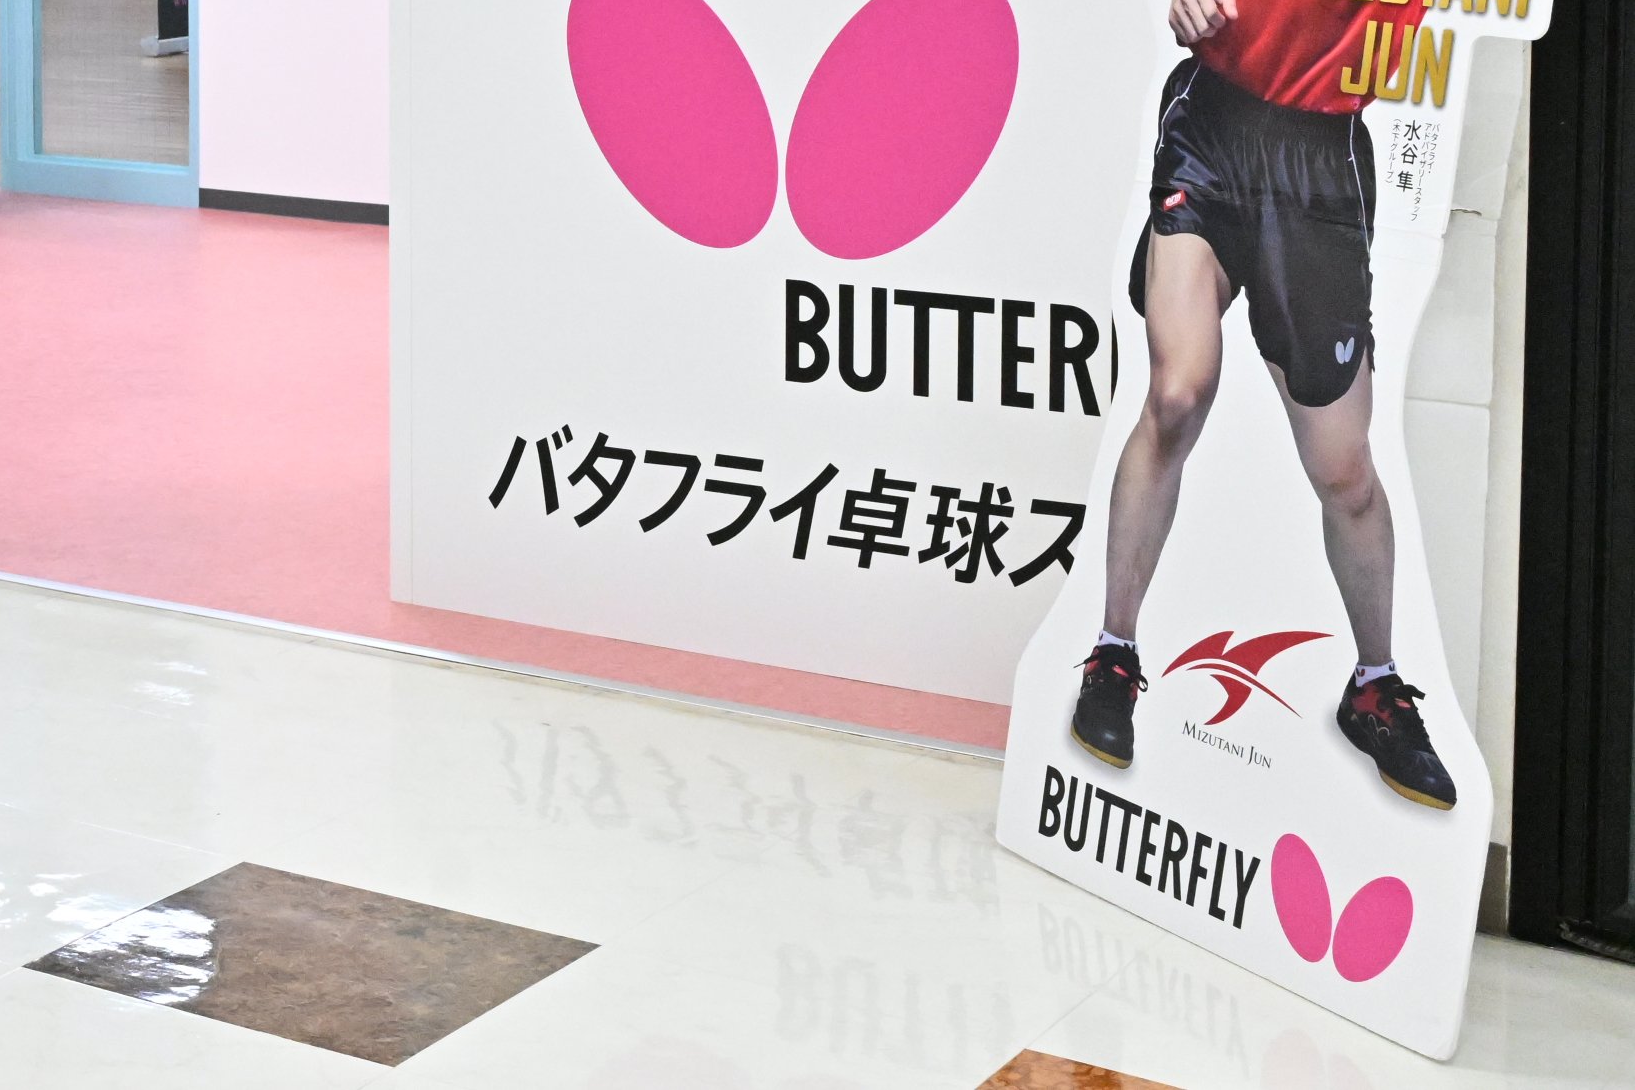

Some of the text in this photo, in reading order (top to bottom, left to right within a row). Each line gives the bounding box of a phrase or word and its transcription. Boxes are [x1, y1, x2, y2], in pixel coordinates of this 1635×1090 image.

[1340, 20, 1455, 108] JUN
[1396, 119, 1422, 192] 水谷 隼
[785, 279, 1118, 417] BUTTER
[489, 424, 1086, 587] バタフライ卓球ス
[1038, 764, 1261, 929] BUTTERFLY
